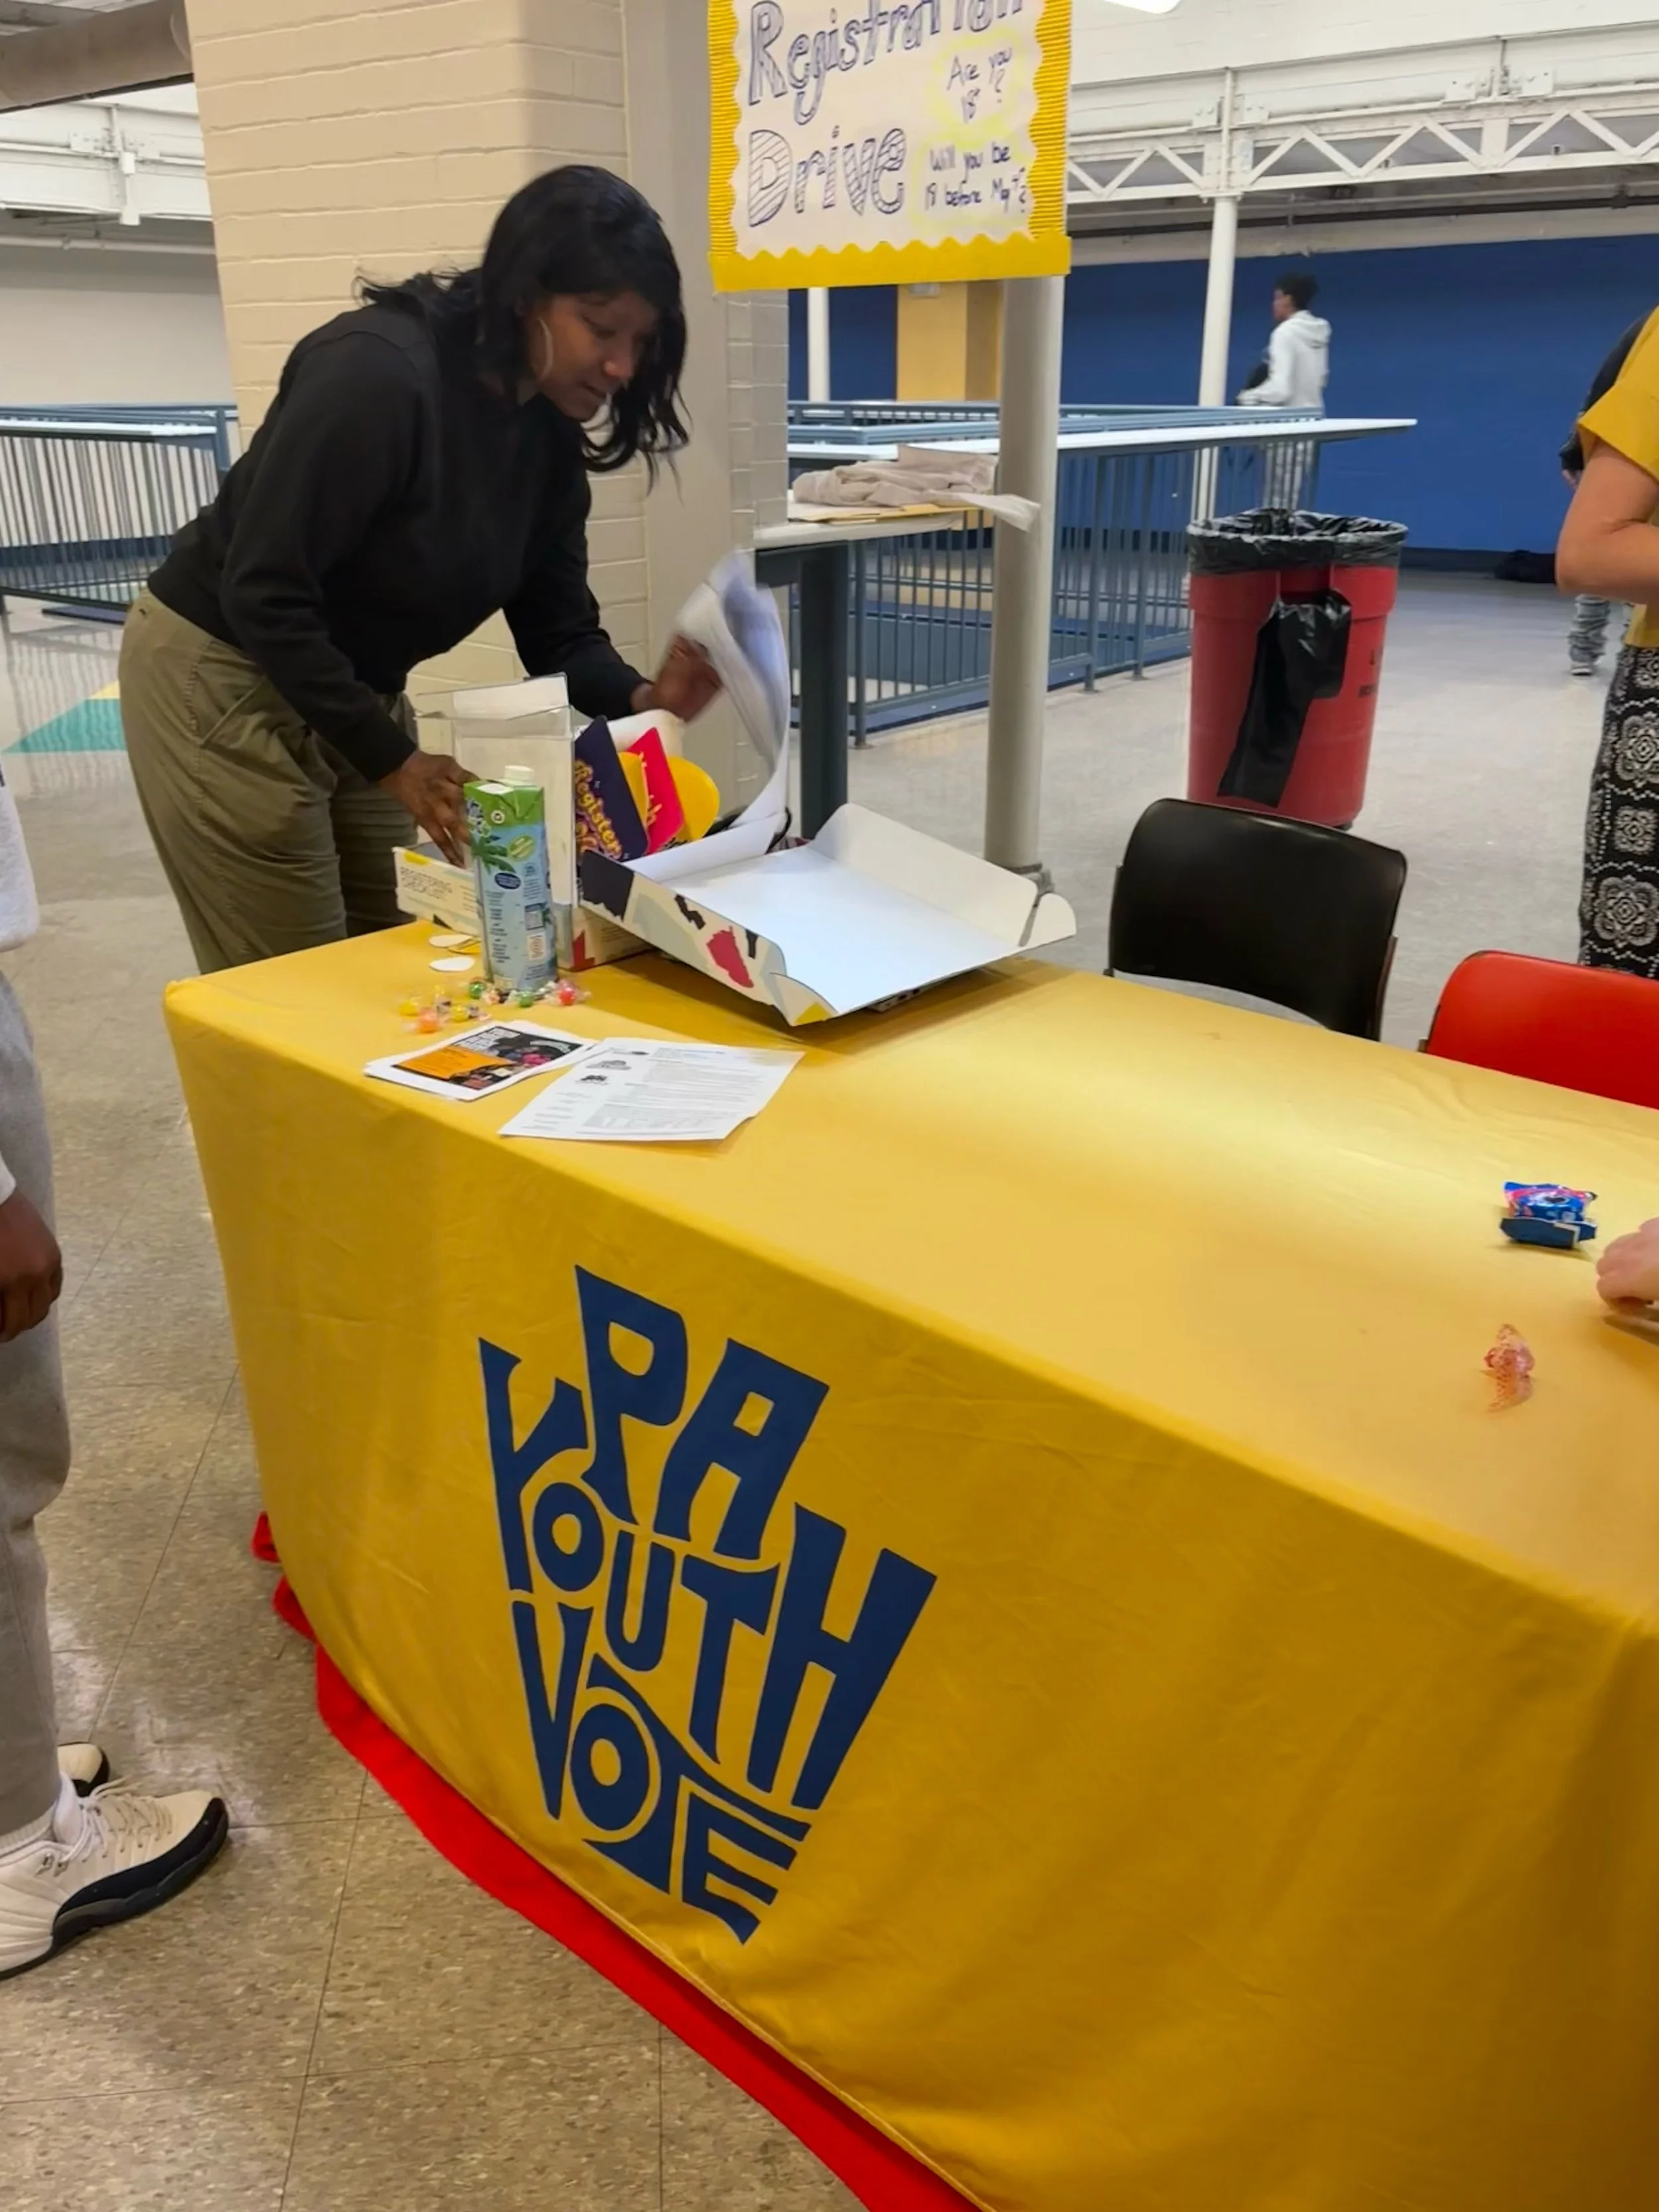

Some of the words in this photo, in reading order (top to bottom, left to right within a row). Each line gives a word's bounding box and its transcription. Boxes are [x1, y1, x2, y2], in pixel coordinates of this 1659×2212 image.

[748, 0, 1023, 125] Registrao
[946, 56, 980, 91] Are
[988, 47, 1012, 84] you
[748, 125, 907, 227] Drive
[930, 144, 956, 171] Will
[964, 152, 983, 183] you
[992, 141, 1011, 163] be
[944, 183, 982, 208] before
[575, 759, 624, 859] Register
[575, 1264, 830, 1560] PA
[478, 1337, 938, 1810] YOUTH
[511, 1599, 812, 1946] VOTE
